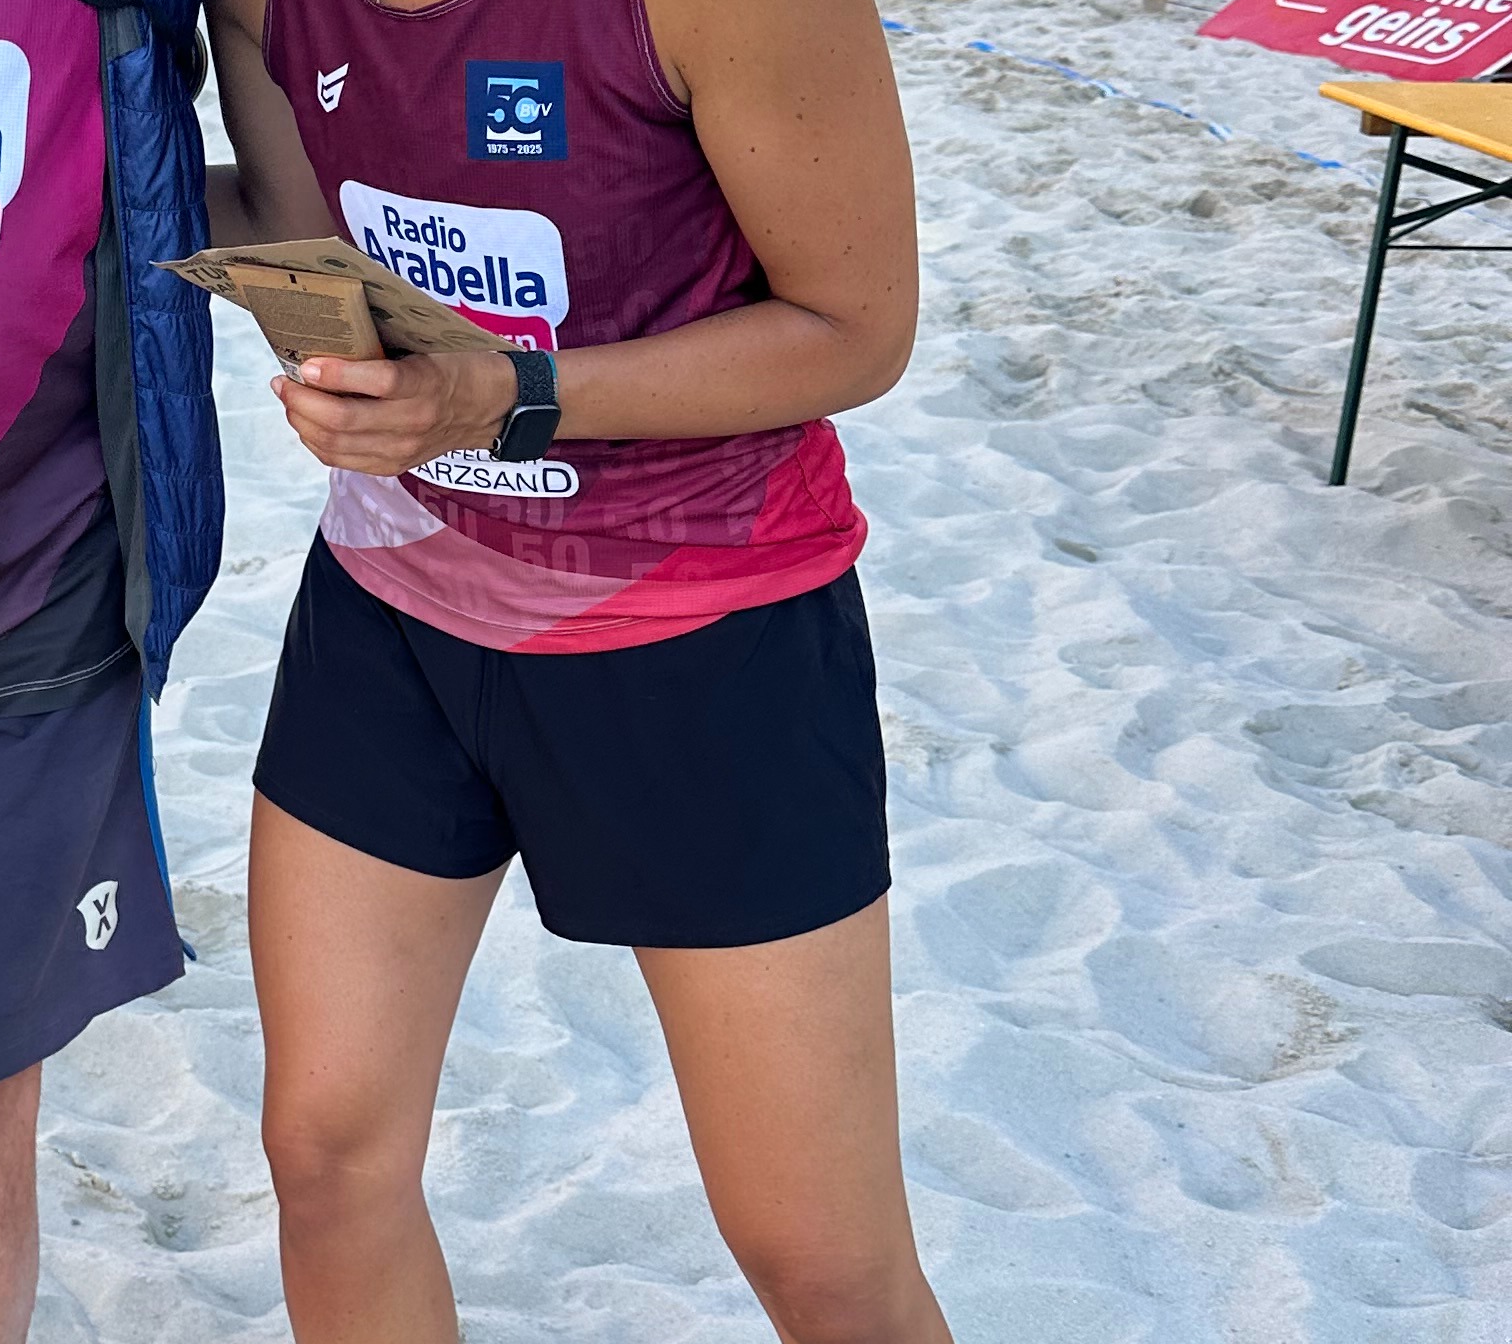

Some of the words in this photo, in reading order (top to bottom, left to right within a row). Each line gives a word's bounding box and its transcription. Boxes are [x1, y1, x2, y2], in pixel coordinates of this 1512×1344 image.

[1318, 4, 1481, 54] geins
[519, 102, 553, 118] BVV
[382, 204, 467, 253] Radio
[363, 225, 548, 308] Arabella
[416, 460, 573, 493] ARZSAND
